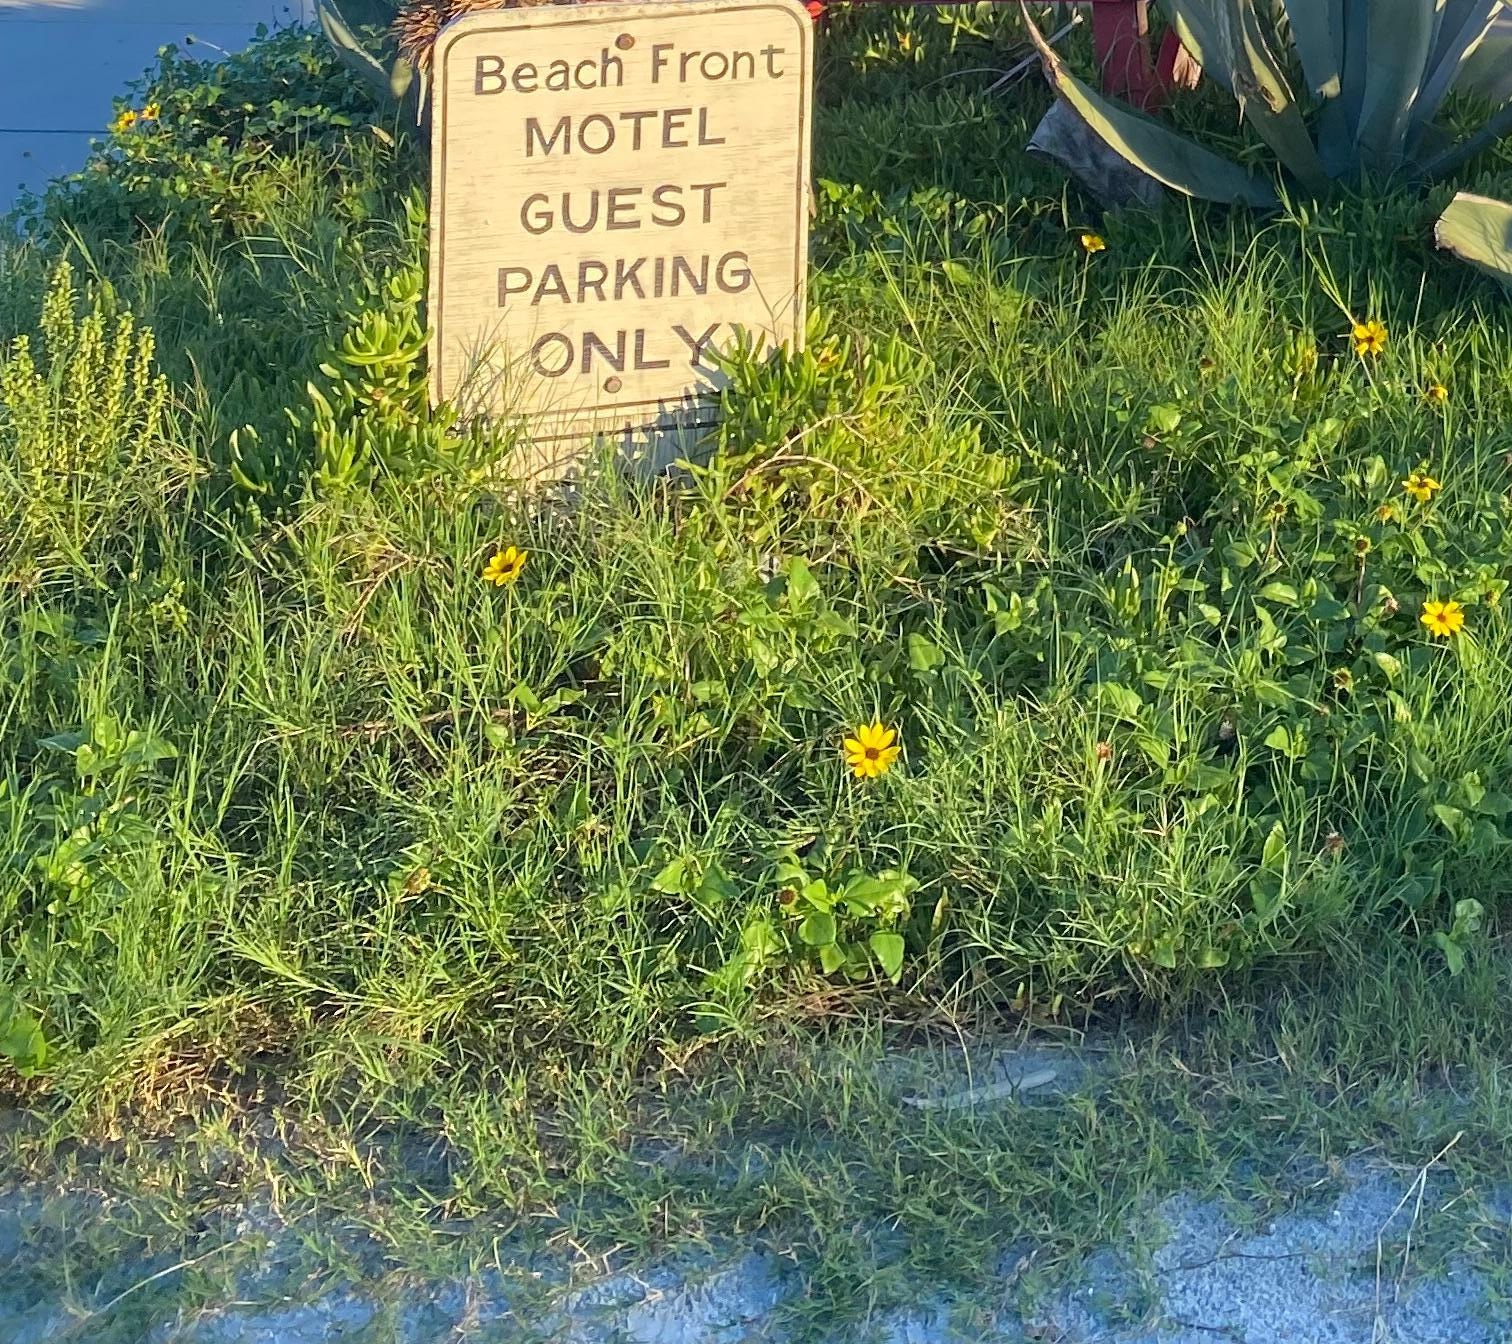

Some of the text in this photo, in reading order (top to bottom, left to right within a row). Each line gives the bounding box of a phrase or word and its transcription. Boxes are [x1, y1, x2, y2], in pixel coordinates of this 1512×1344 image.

[475, 42, 785, 96] Beach Front
[526, 107, 725, 157] MOTEL
[520, 182, 726, 235] GUEST
[497, 251, 751, 307] PARKING
[533, 323, 721, 378] ONLY
